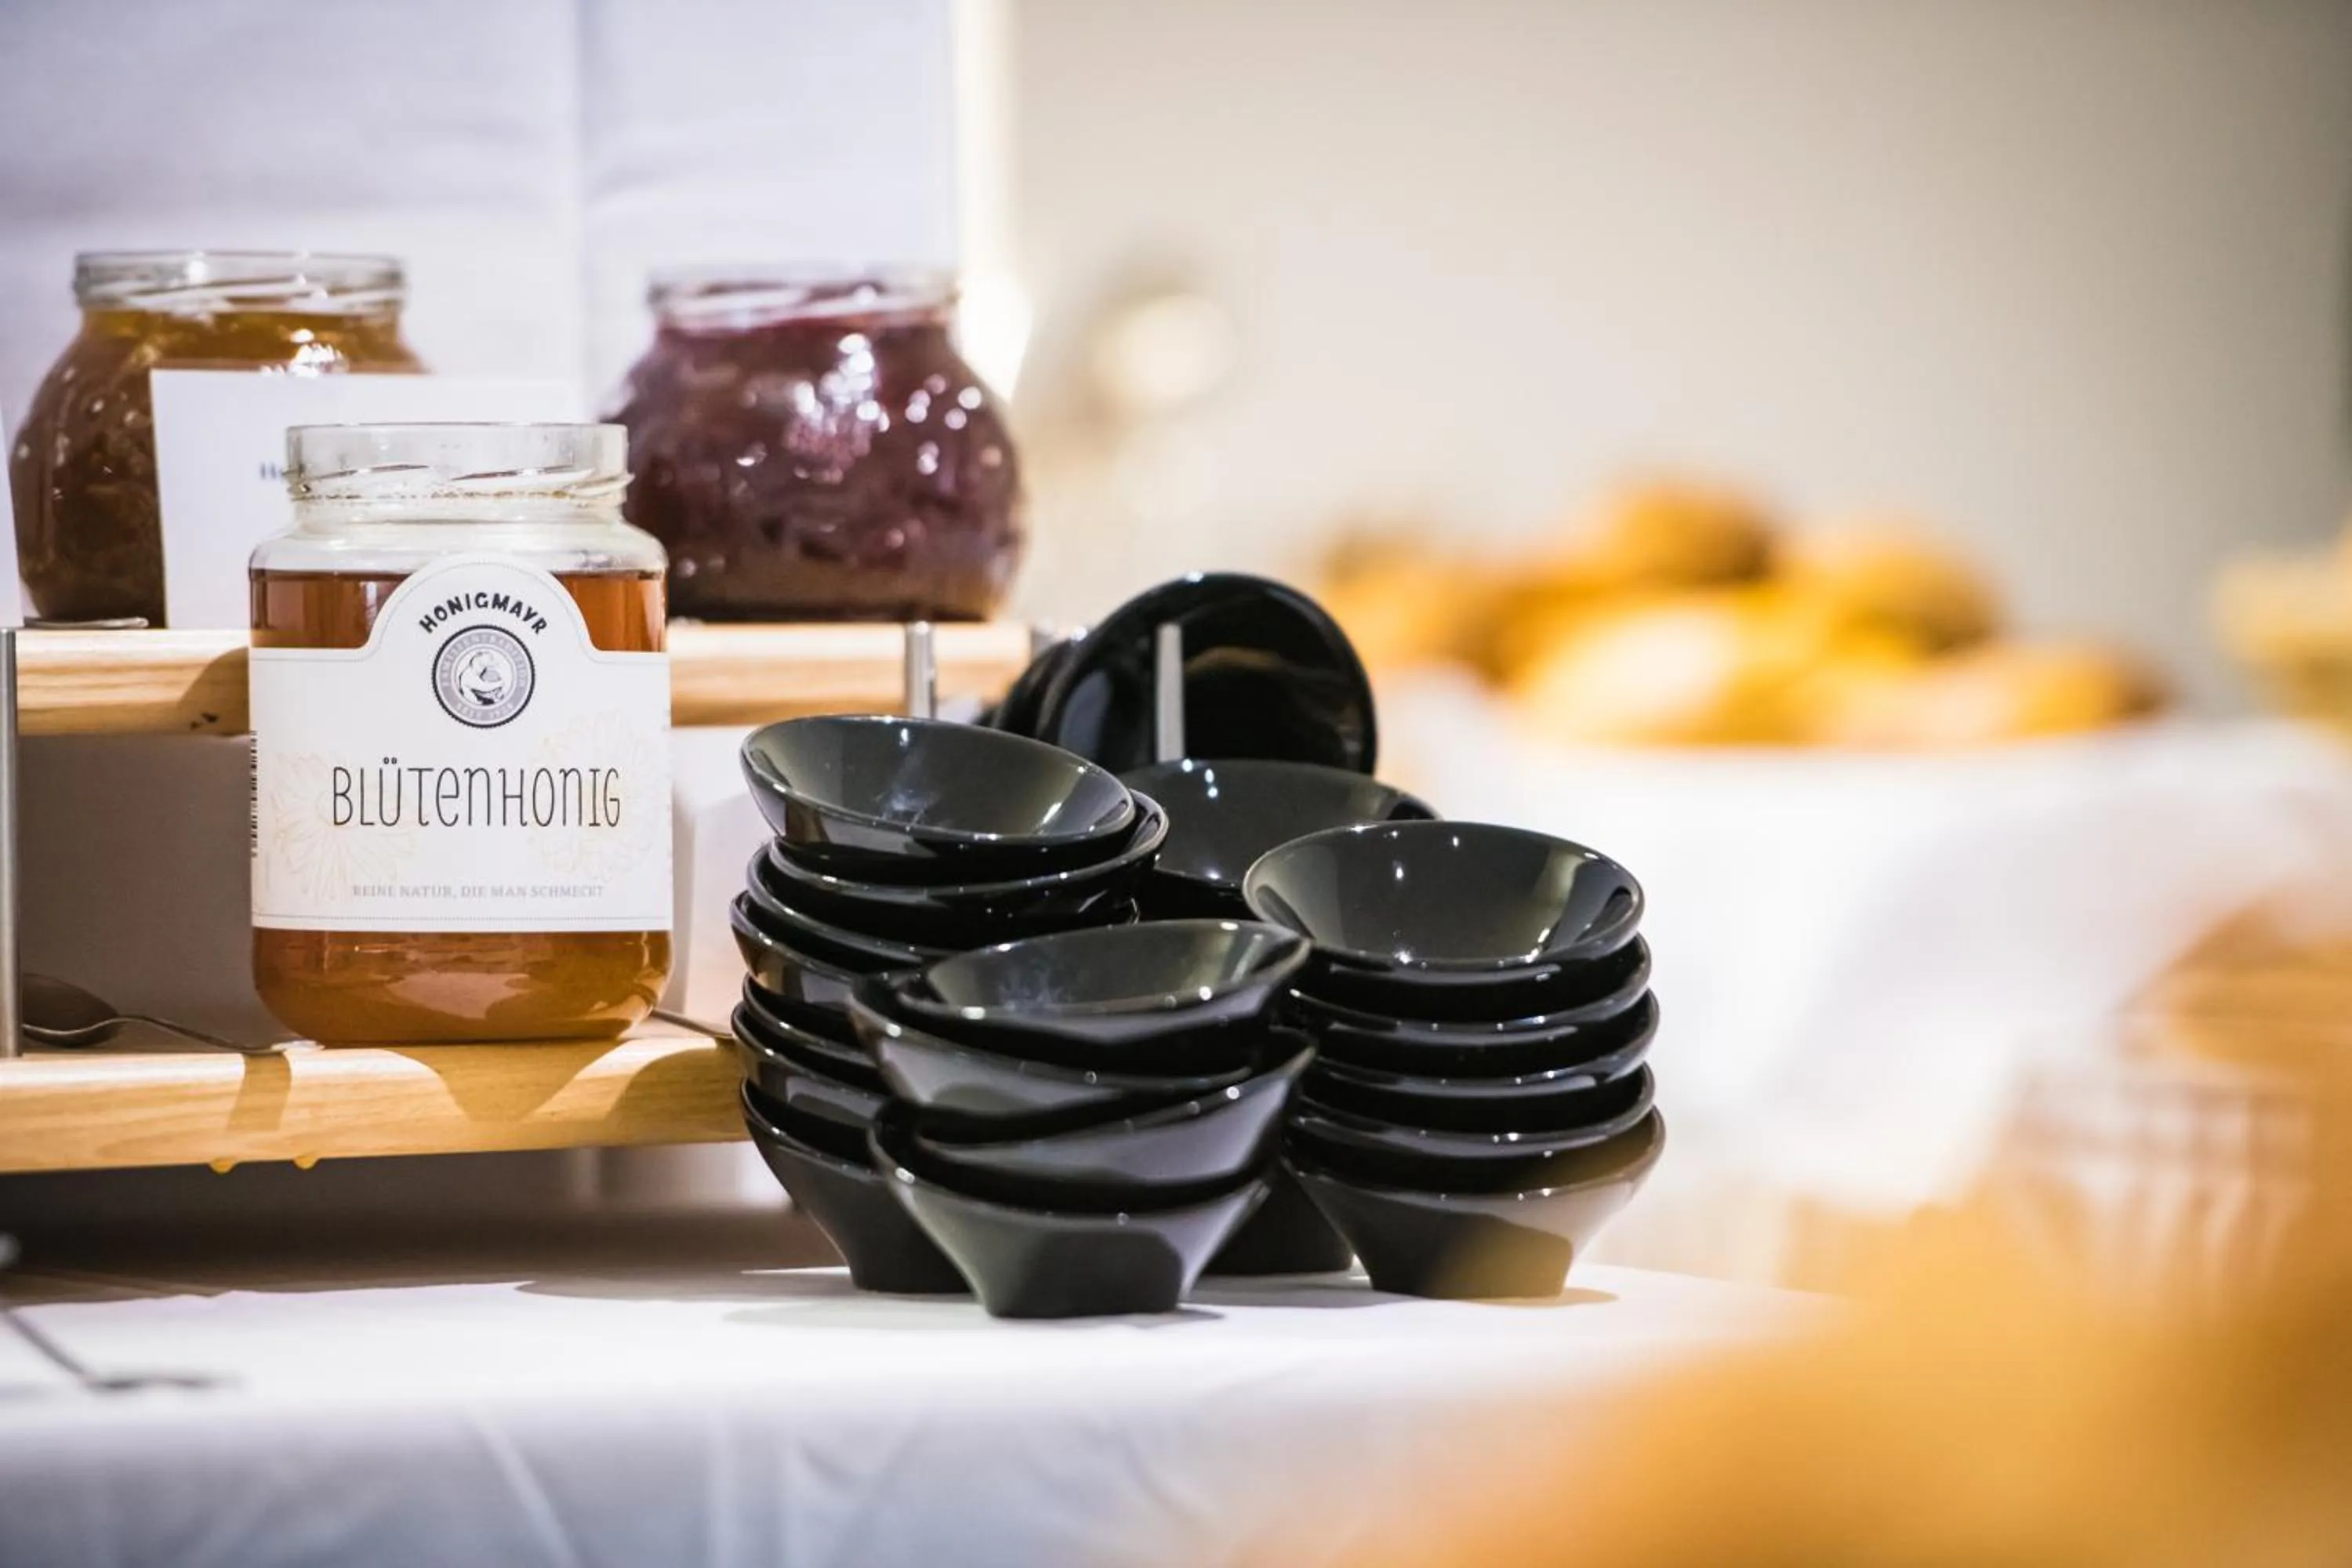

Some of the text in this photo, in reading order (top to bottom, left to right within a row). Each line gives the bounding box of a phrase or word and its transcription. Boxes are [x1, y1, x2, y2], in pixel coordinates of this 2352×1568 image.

[419, 592, 548, 633] HONIGMAYR
[353, 884, 394, 898] REINE
[461, 884, 488, 898] DIE
[490, 884, 527, 898] MAN
